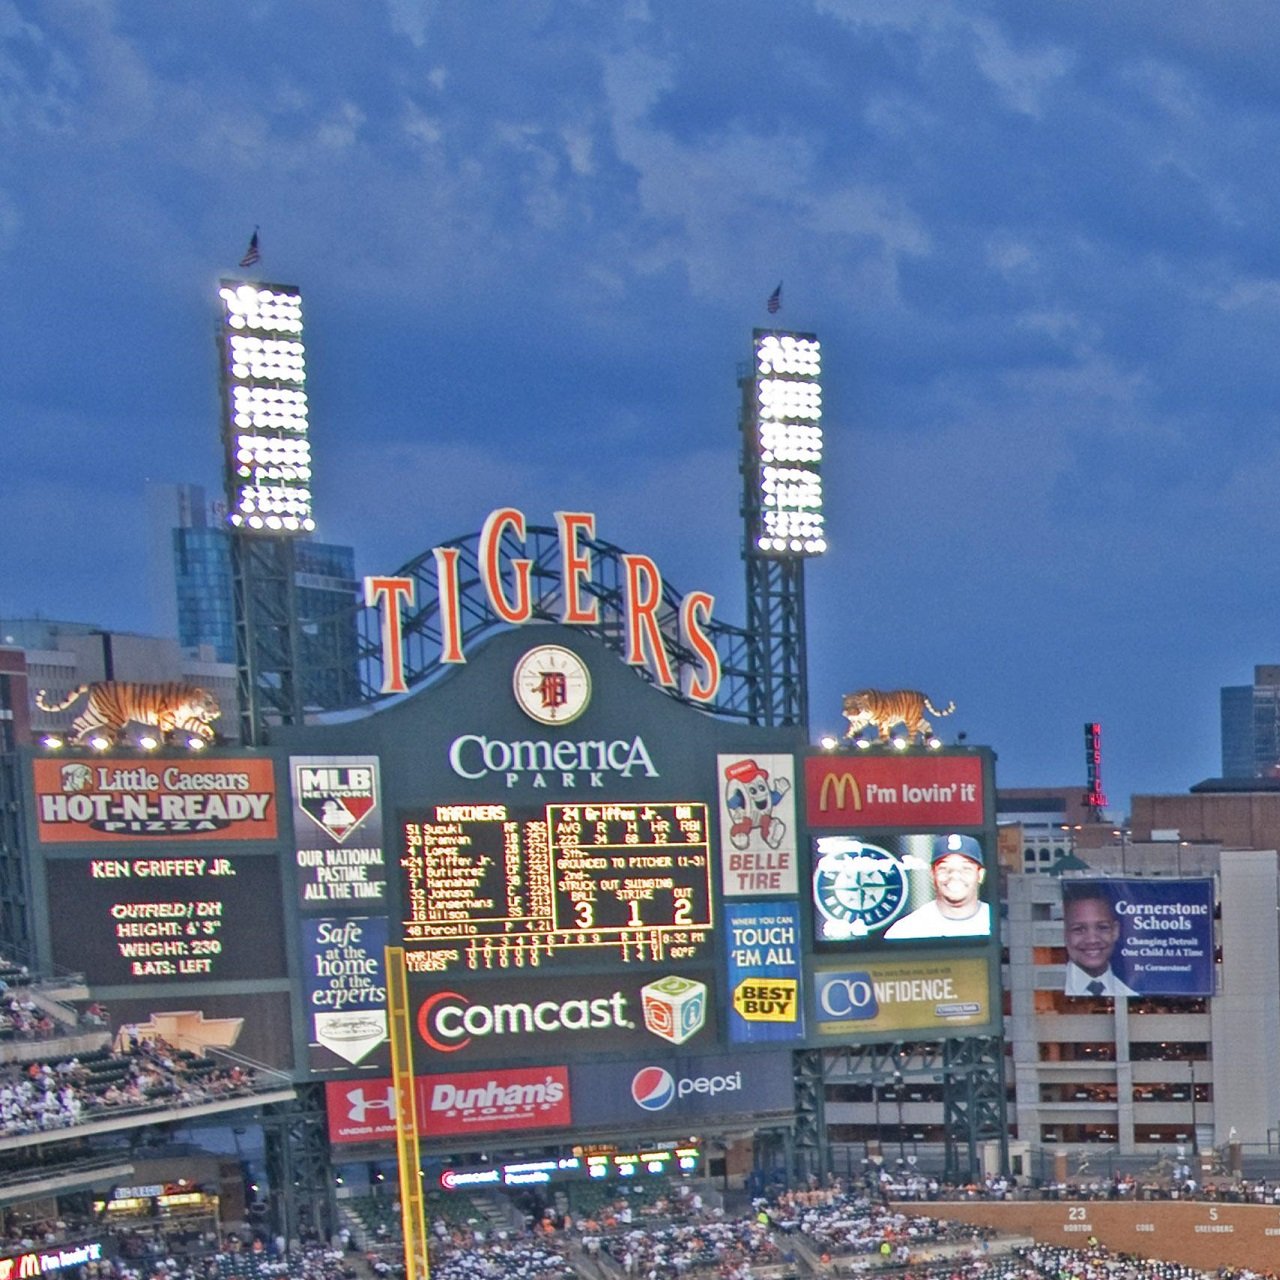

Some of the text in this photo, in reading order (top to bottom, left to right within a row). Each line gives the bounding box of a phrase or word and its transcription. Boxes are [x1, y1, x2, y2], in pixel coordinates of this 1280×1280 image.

[363, 506, 721, 702] TIGERS
[98, 767, 249, 791] Little Caesars
[301, 769, 371, 790] MLB
[506, 772, 604, 789] PARK
[302, 790, 371, 798] NETWORK
[867, 784, 976, 804] i'm lovin' it
[41, 794, 270, 822] HOT-N-READY
[436, 805, 507, 822] MARINERS
[562, 807, 580, 822] 24
[105, 821, 217, 831] PIZZA
[423, 823, 463, 834] Suzuki
[557, 822, 582, 834] AVG
[651, 821, 670, 832] HR
[297, 848, 384, 866] OUR NATIONAL
[557, 856, 672, 869] GROUNDED TO PITCHER
[729, 853, 790, 872] BELLE
[91, 859, 236, 878] KEN GRIFFEY JR.
[316, 866, 367, 882] PASTIME
[558, 880, 597, 892] STRUCK
[600, 878, 620, 890] OUT
[737, 872, 781, 891] TIRE
[304, 882, 351, 900] ALL THE
[616, 889, 654, 900] STRIKE
[673, 888, 693, 898] OUT
[574, 901, 593, 929] 3
[628, 900, 643, 927] 1
[674, 899, 693, 925] 2
[1115, 900, 1208, 916] Cornerstone
[731, 916, 793, 926] WHERE YOU CAN
[1133, 915, 1192, 931] Schools
[116, 922, 182, 937] HEIGHT:
[316, 922, 362, 947] Safe
[424, 924, 478, 935] Porcello
[690, 931, 706, 942] PM
[733, 929, 795, 946] TOUCH
[119, 940, 222, 957] WEIGHT: 230
[1126, 936, 1198, 946] Changing Detroit
[325, 946, 366, 960] at the
[732, 948, 795, 968] 'EM ALL
[1121, 947, 1204, 957] One Child Time
[132, 959, 212, 975] BATS: LEFT
[315, 955, 378, 977] home
[330, 975, 371, 989] of the
[312, 985, 386, 1009] experts
[742, 986, 795, 1000] BEST
[743, 1000, 790, 1015] BUY
[678, 1071, 742, 1099] pepsi
[431, 1076, 564, 1111] Dunham's
[445, 1103, 553, 1118] SPORTS
[339, 1126, 373, 1136] UNDER
[1068, 1207, 1087, 1221] 23
[1209, 1207, 1218, 1220] 5
